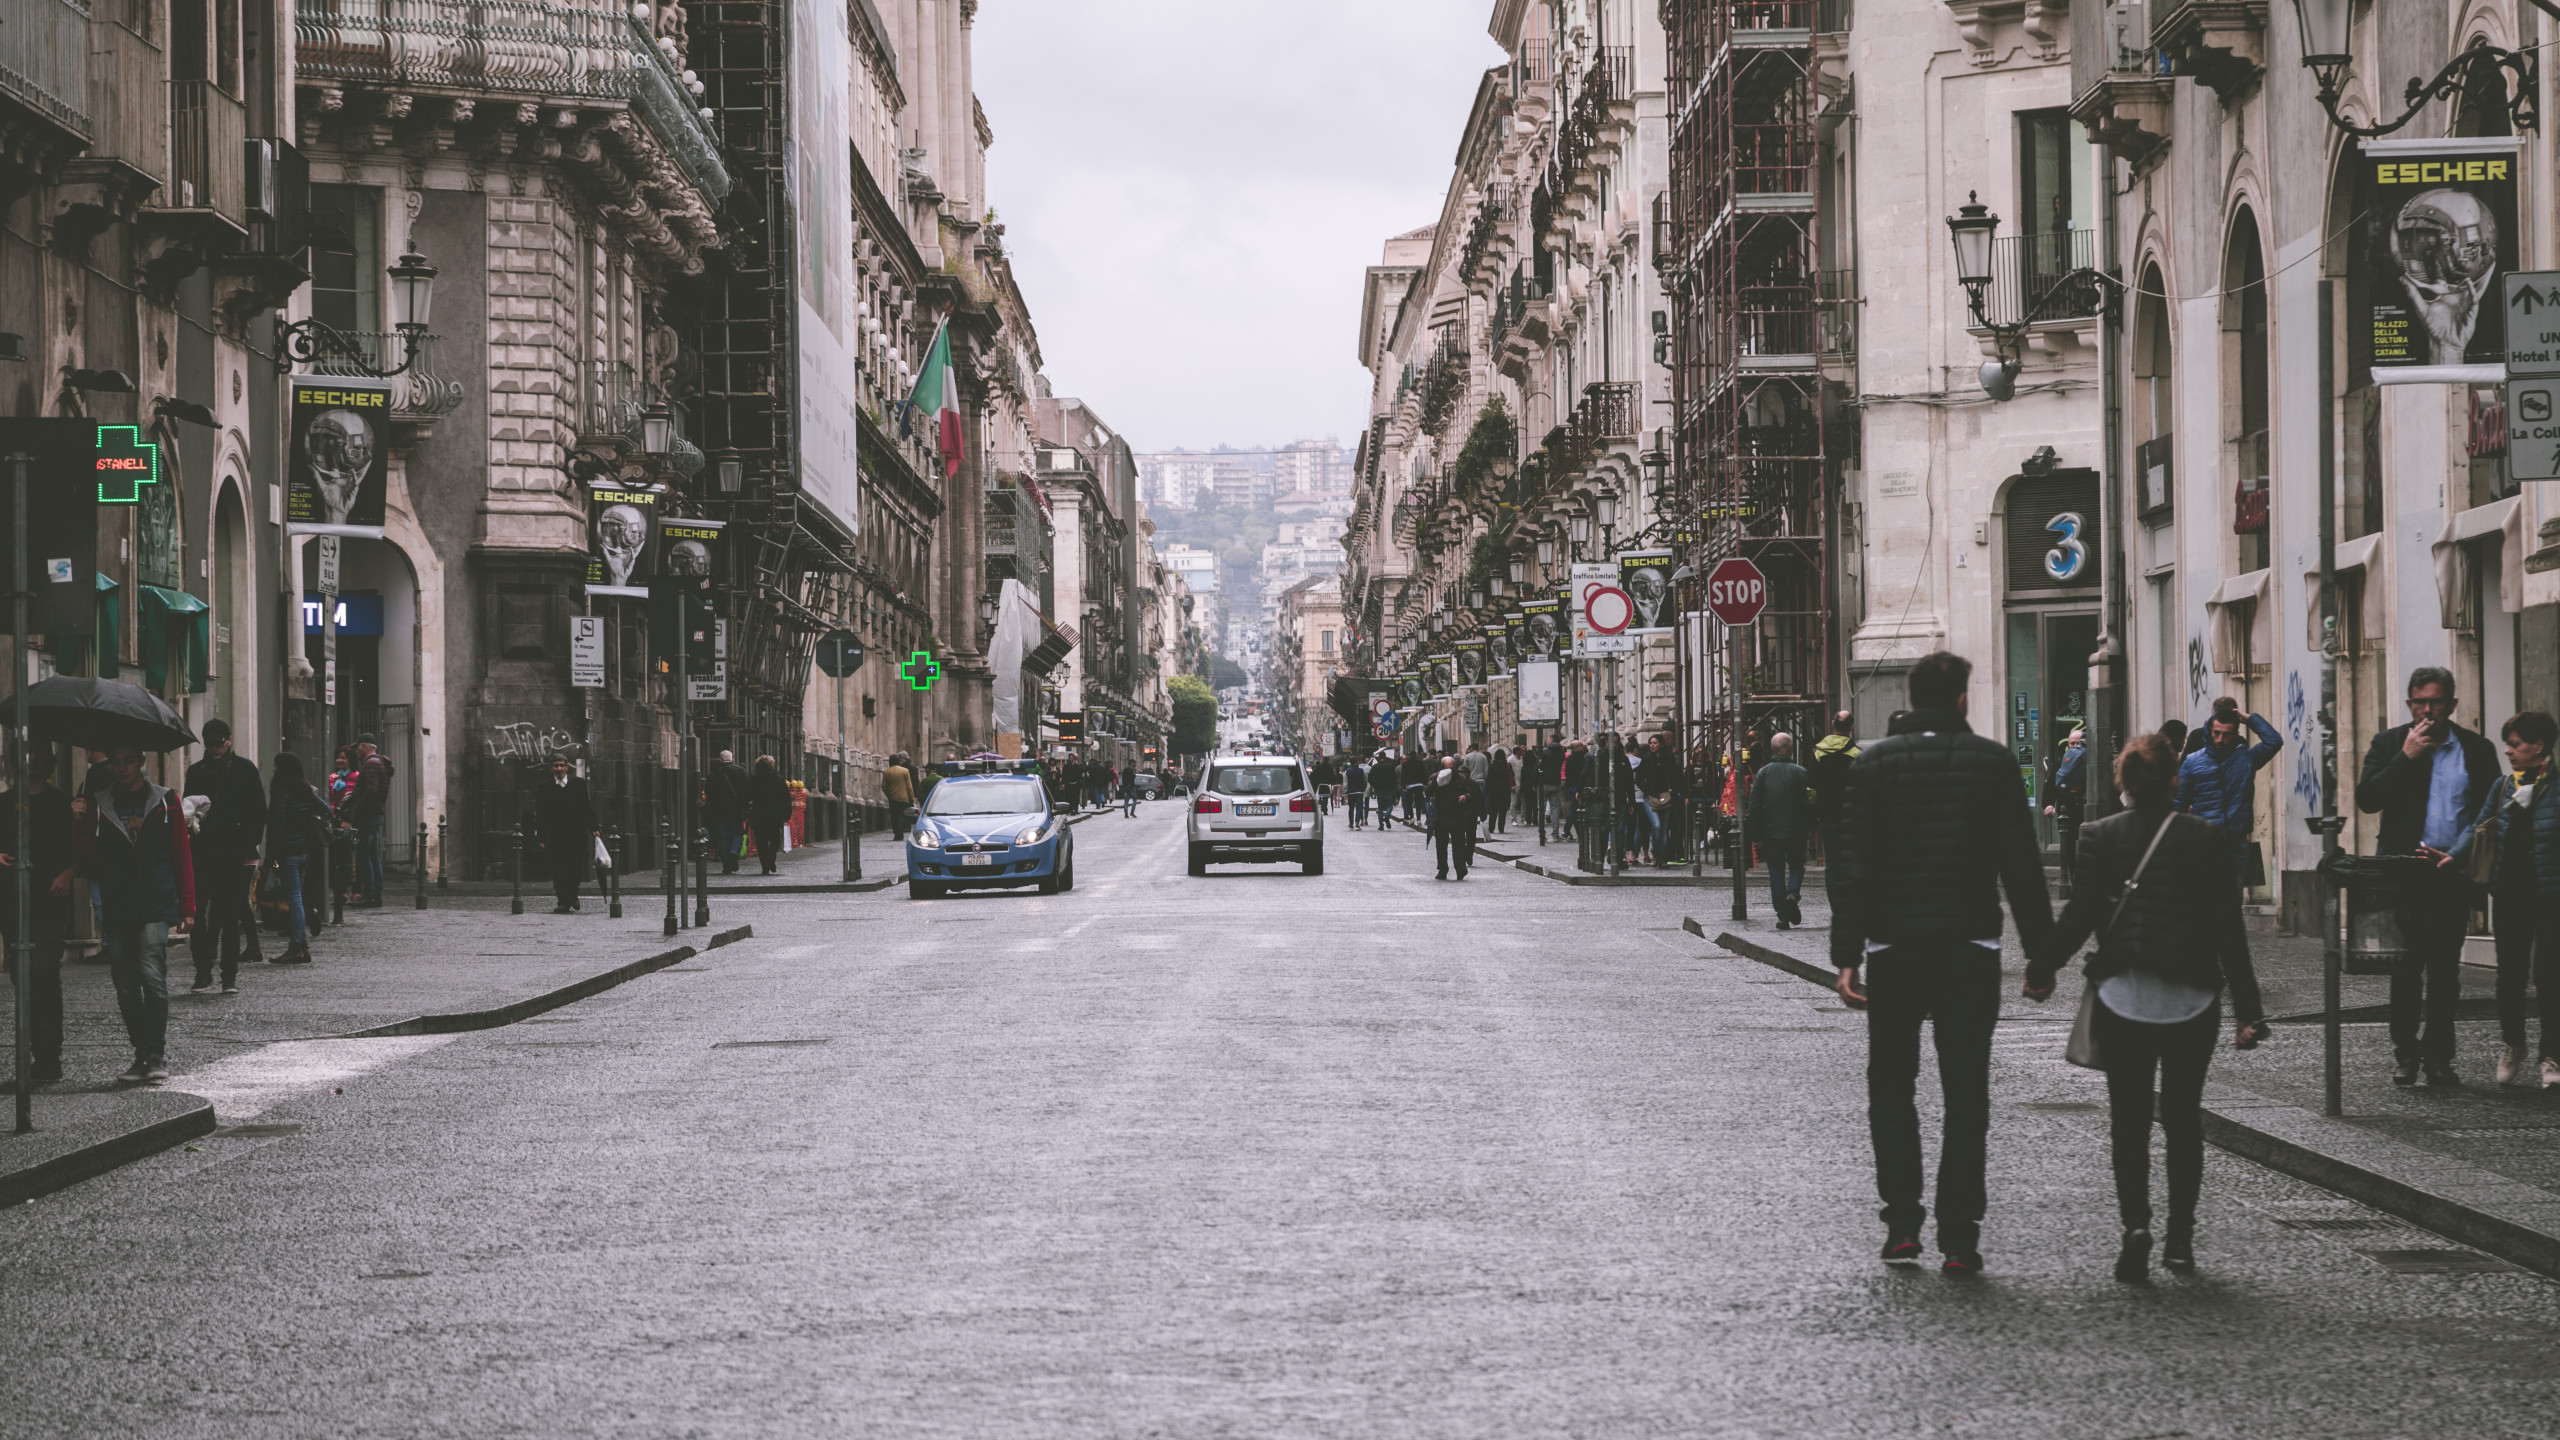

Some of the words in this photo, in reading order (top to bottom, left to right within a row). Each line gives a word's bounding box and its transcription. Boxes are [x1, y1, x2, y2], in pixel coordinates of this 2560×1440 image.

[2377, 160, 2507, 184] ESCHER
[2374, 336, 2408, 344] CULTURA
[2375, 348, 2407, 356] CATANIA
[2511, 350, 2550, 362] Hotel
[299, 390, 384, 407] ESCHER
[2512, 428, 2527, 440] La
[593, 491, 655, 505] ESCHER
[665, 527, 718, 540] ESCHER
[2045, 512, 2090, 581] 3
[1624, 557, 1669, 567] ESCHER
[1712, 579, 1762, 605] STOP
[1525, 605, 1559, 614] ESCHER
[1378, 727, 1389, 736] 20
[1240, 806, 1249, 814] EZ
